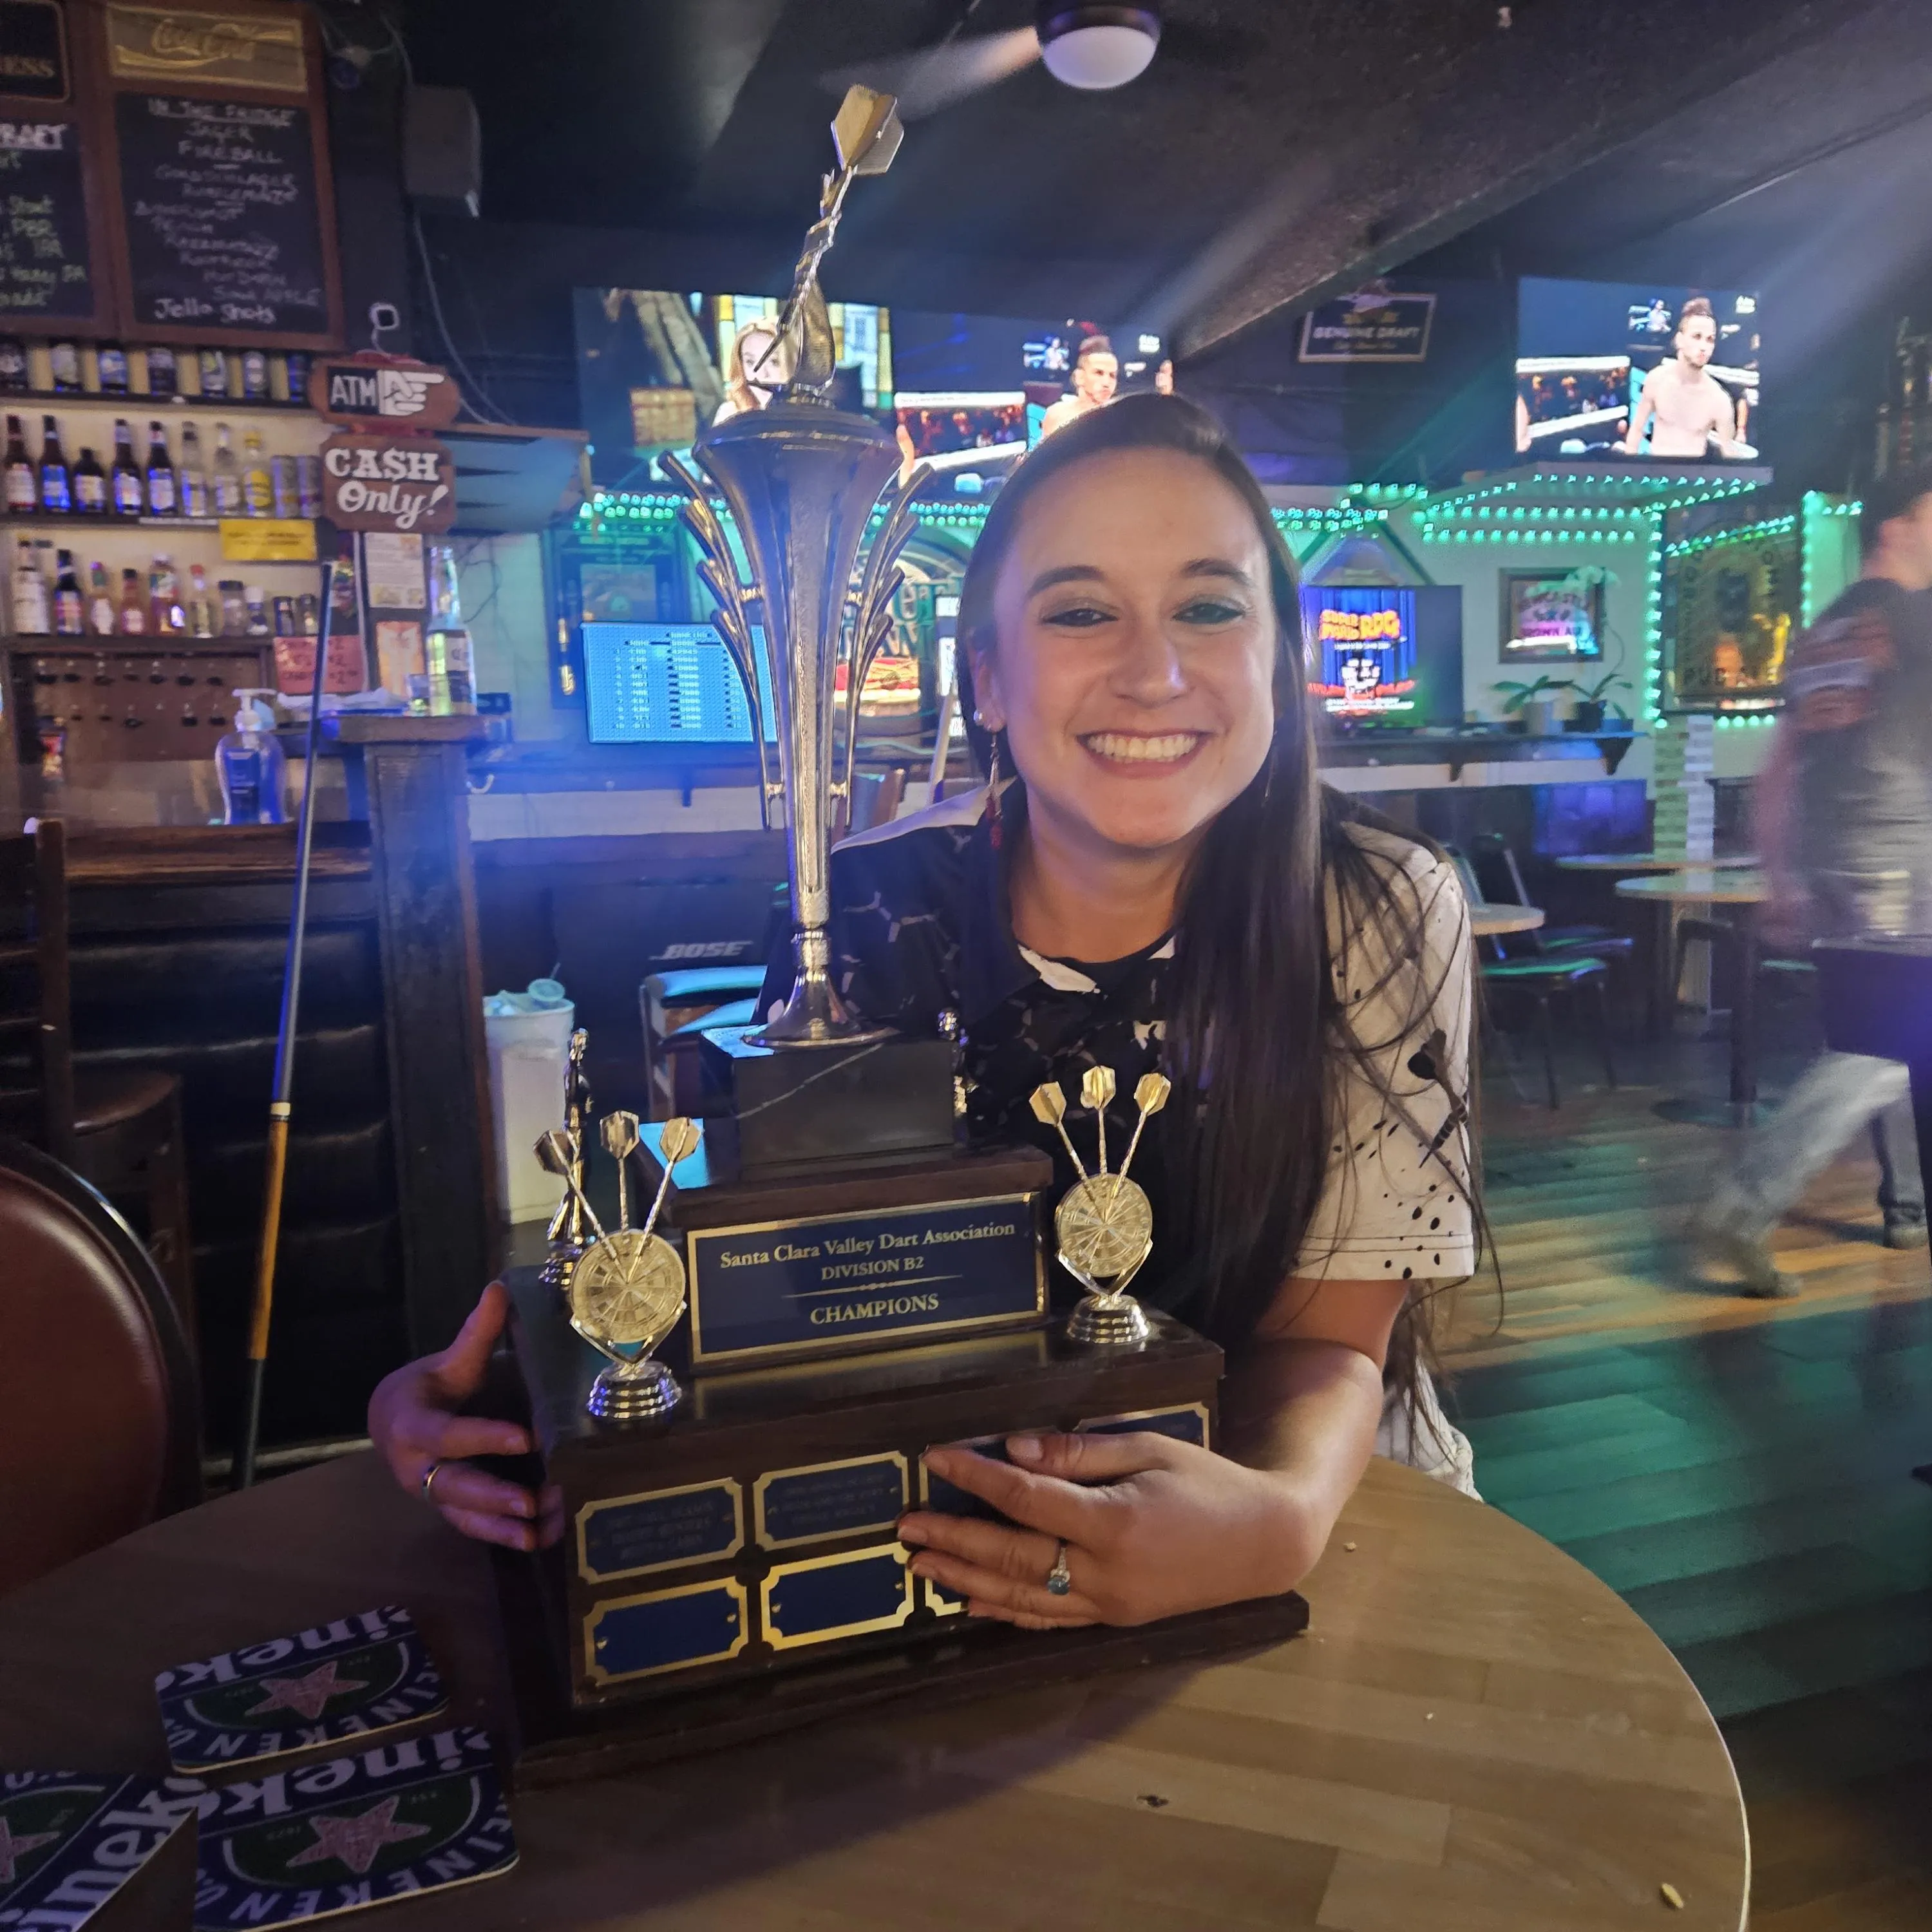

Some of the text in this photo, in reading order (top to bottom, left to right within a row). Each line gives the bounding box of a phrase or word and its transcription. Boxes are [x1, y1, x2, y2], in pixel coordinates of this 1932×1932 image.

[154, 297, 214, 319] Jello
[330, 375, 377, 406] ATM
[337, 480, 450, 530] Only!
[1359, 610, 1401, 640] RPG
[649, 940, 754, 961] BOSE
[720, 1221, 1016, 1269] Santa Clara Valley Dart Association
[821, 1256, 925, 1281] DIVISION B2
[810, 1293, 940, 1325] CHAMPIONS
